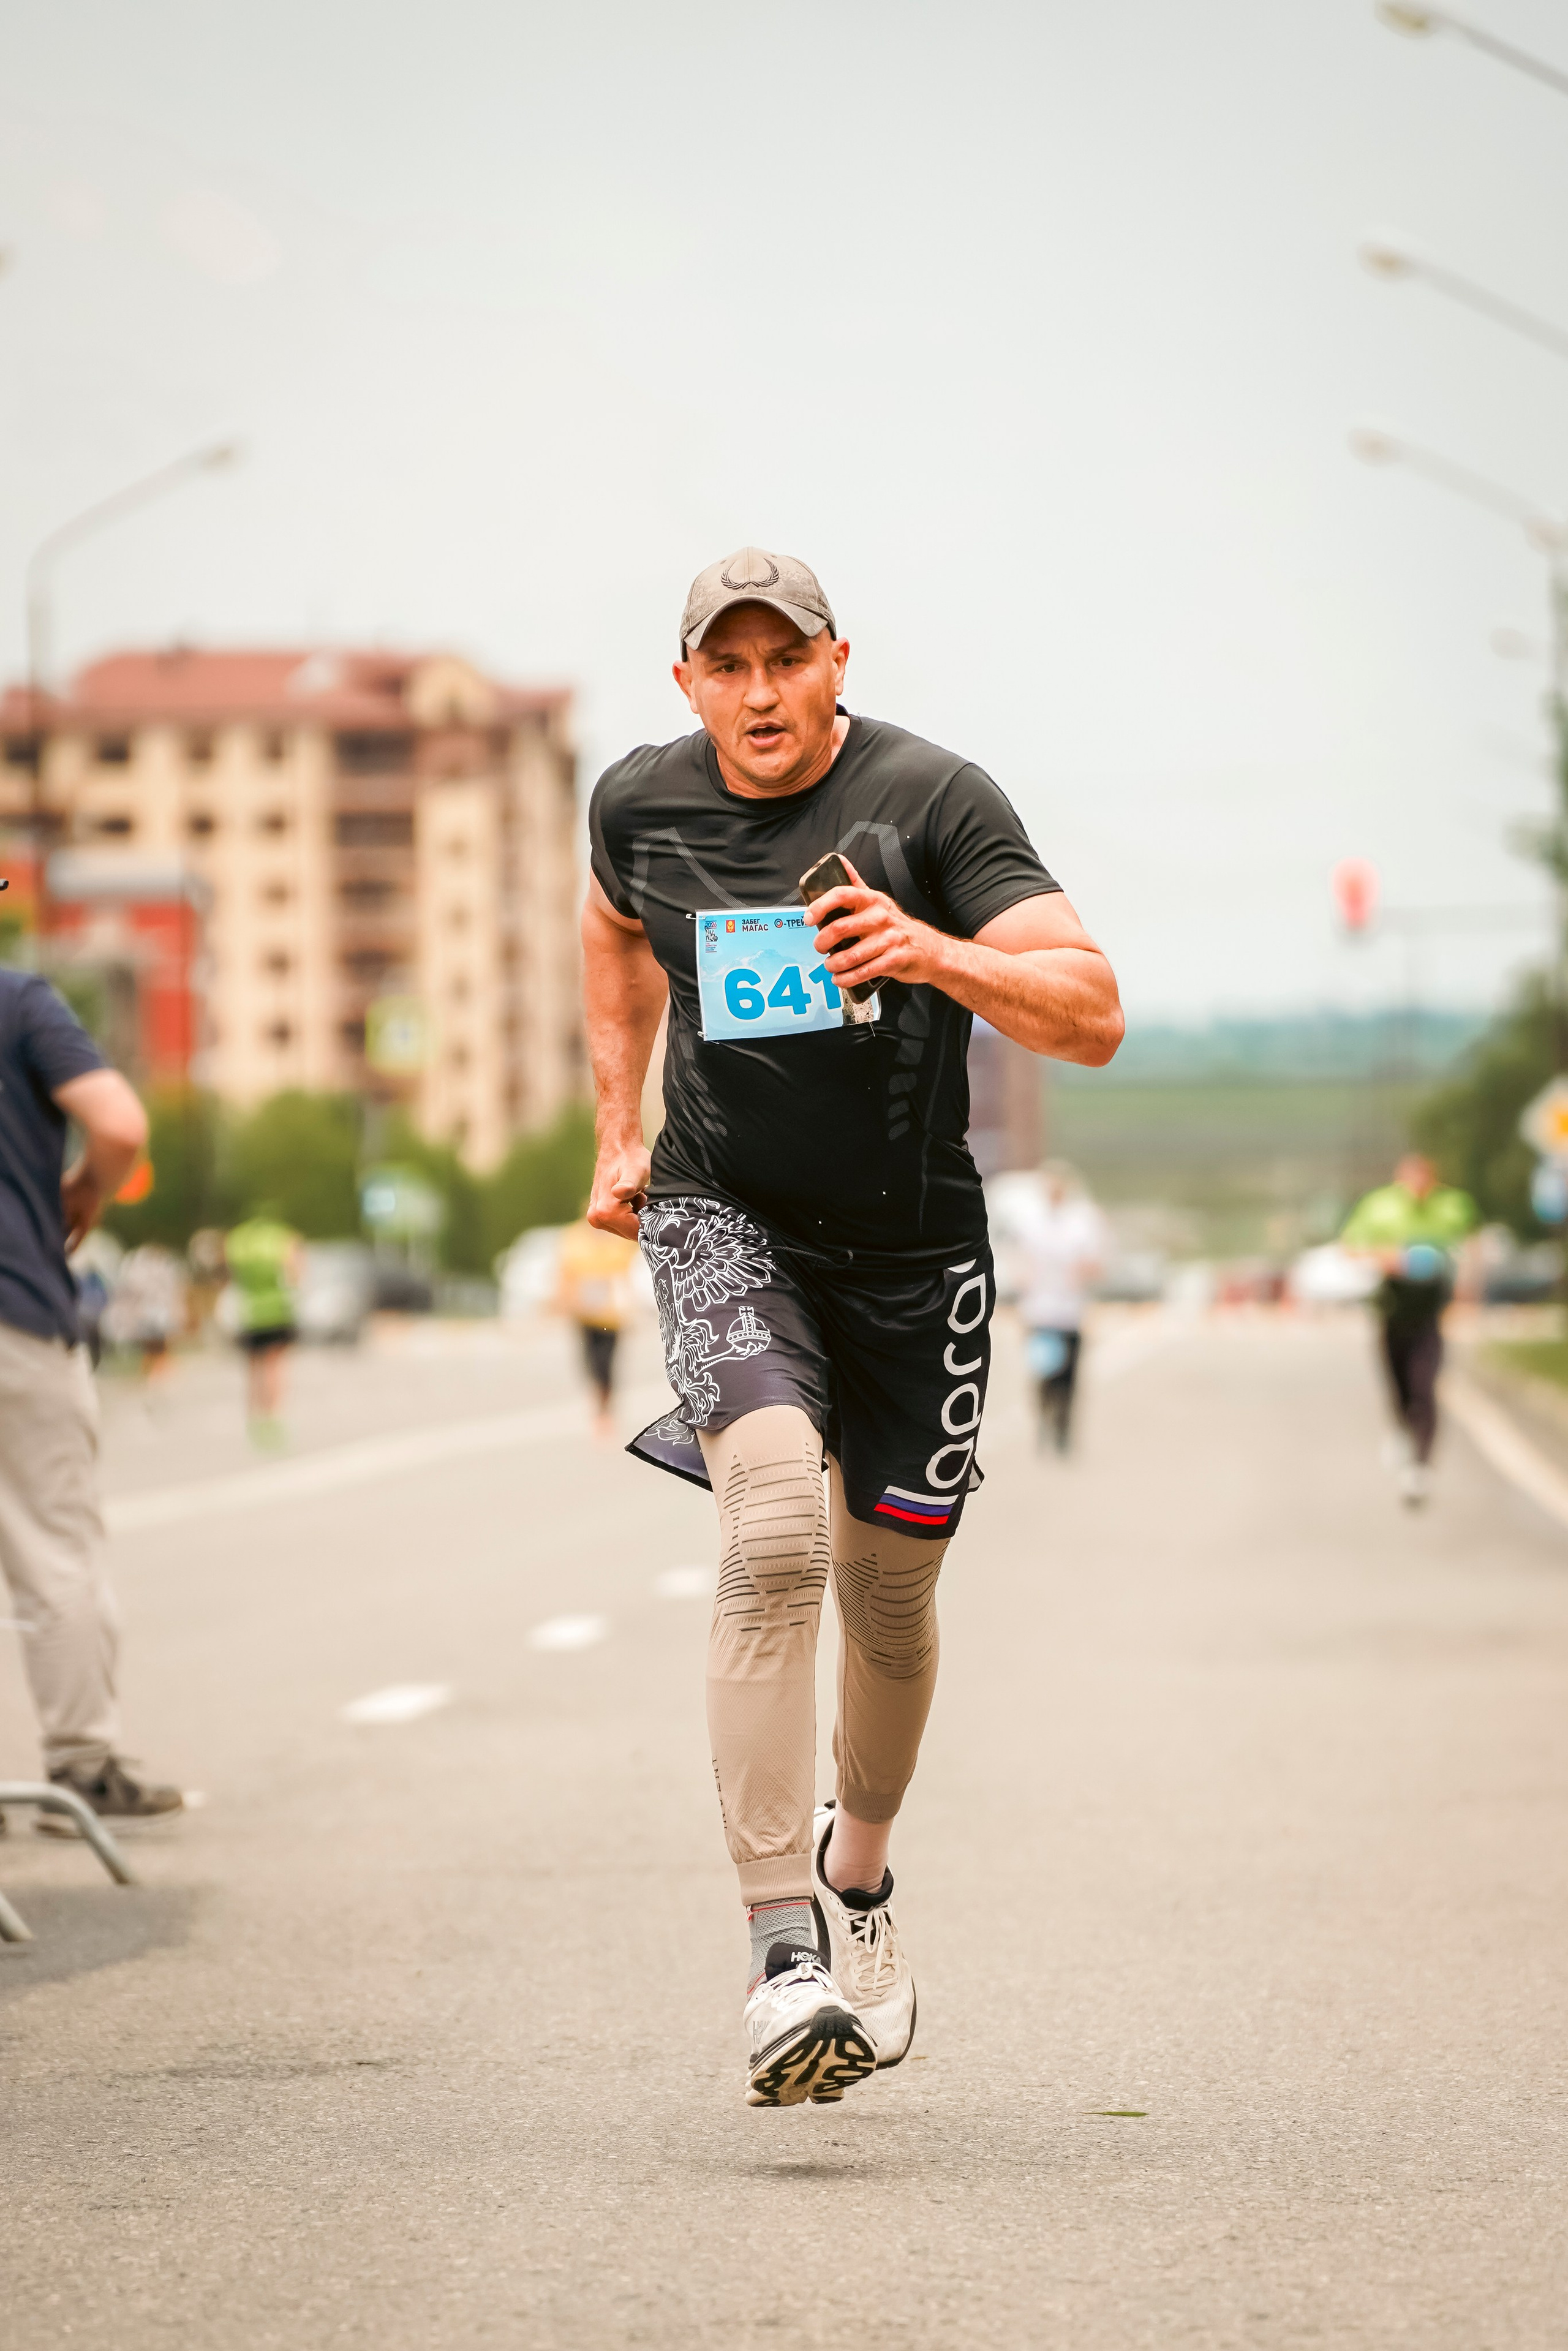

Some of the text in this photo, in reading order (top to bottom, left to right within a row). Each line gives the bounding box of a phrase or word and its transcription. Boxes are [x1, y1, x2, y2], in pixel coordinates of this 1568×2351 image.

[742, 924, 769, 932] МАГАС
[724, 963, 842, 1020] 641
[790, 1951, 821, 1964] HOKA
